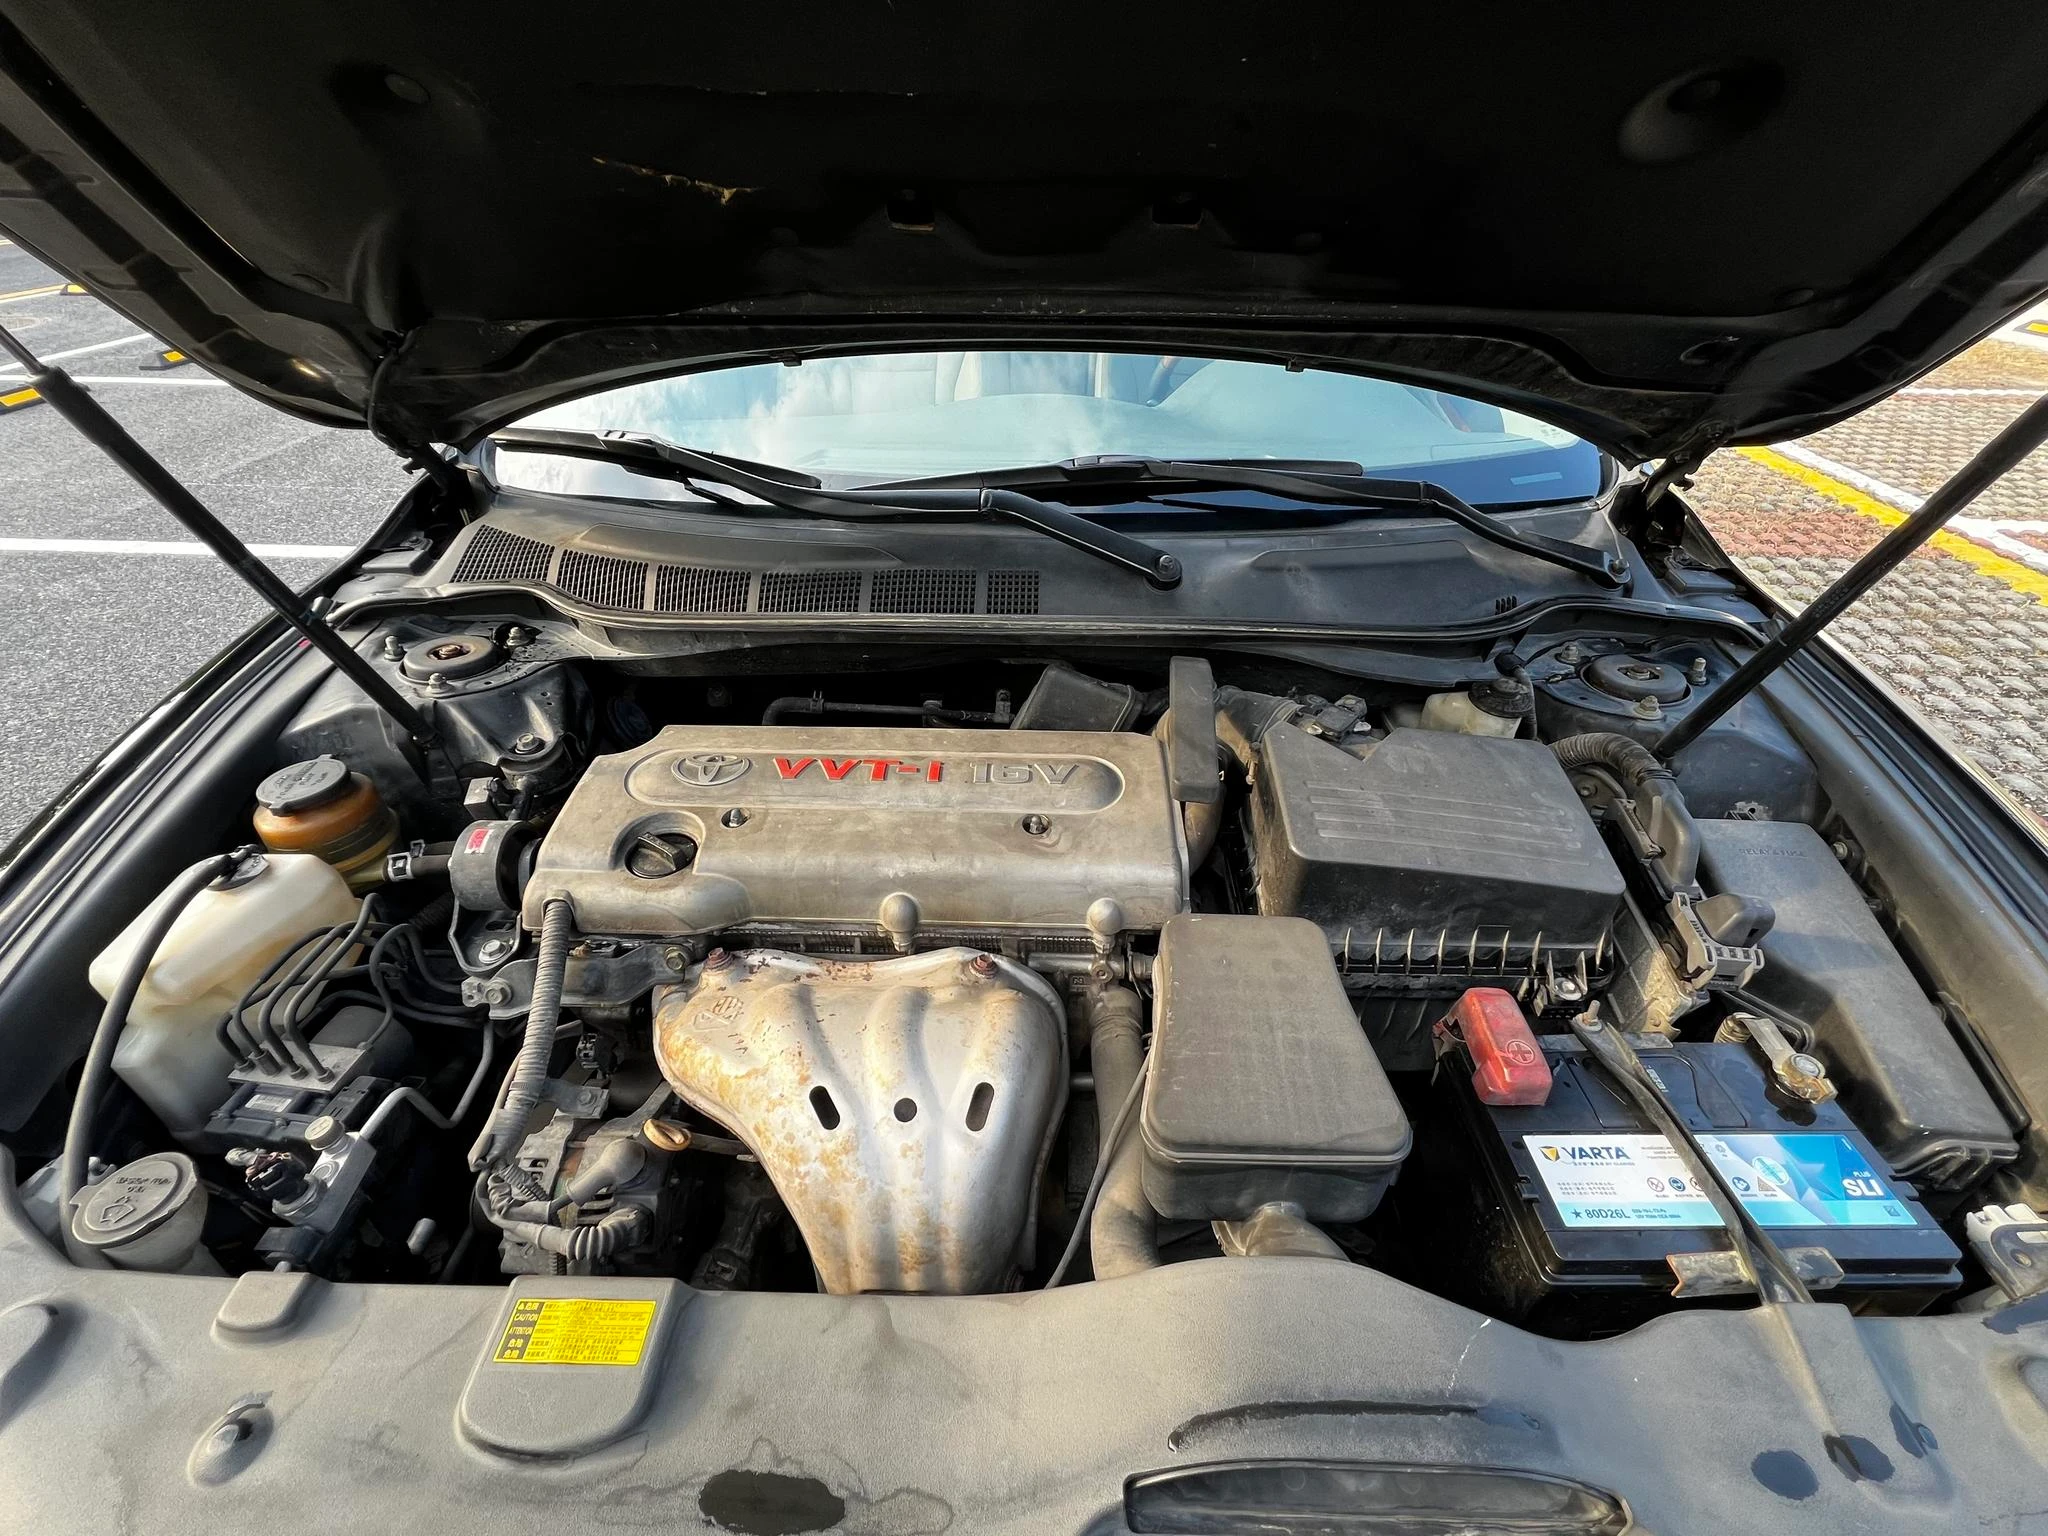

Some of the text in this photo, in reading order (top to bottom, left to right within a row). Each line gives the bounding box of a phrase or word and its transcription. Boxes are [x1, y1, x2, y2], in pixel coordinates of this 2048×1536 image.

[968, 759, 1081, 785] 16V
[1561, 1146, 1631, 1160] VARTA
[1842, 1178, 1885, 1197] SLI
[1584, 1208, 1631, 1220] 80D26L
[513, 1313, 540, 1322] CAUTION
